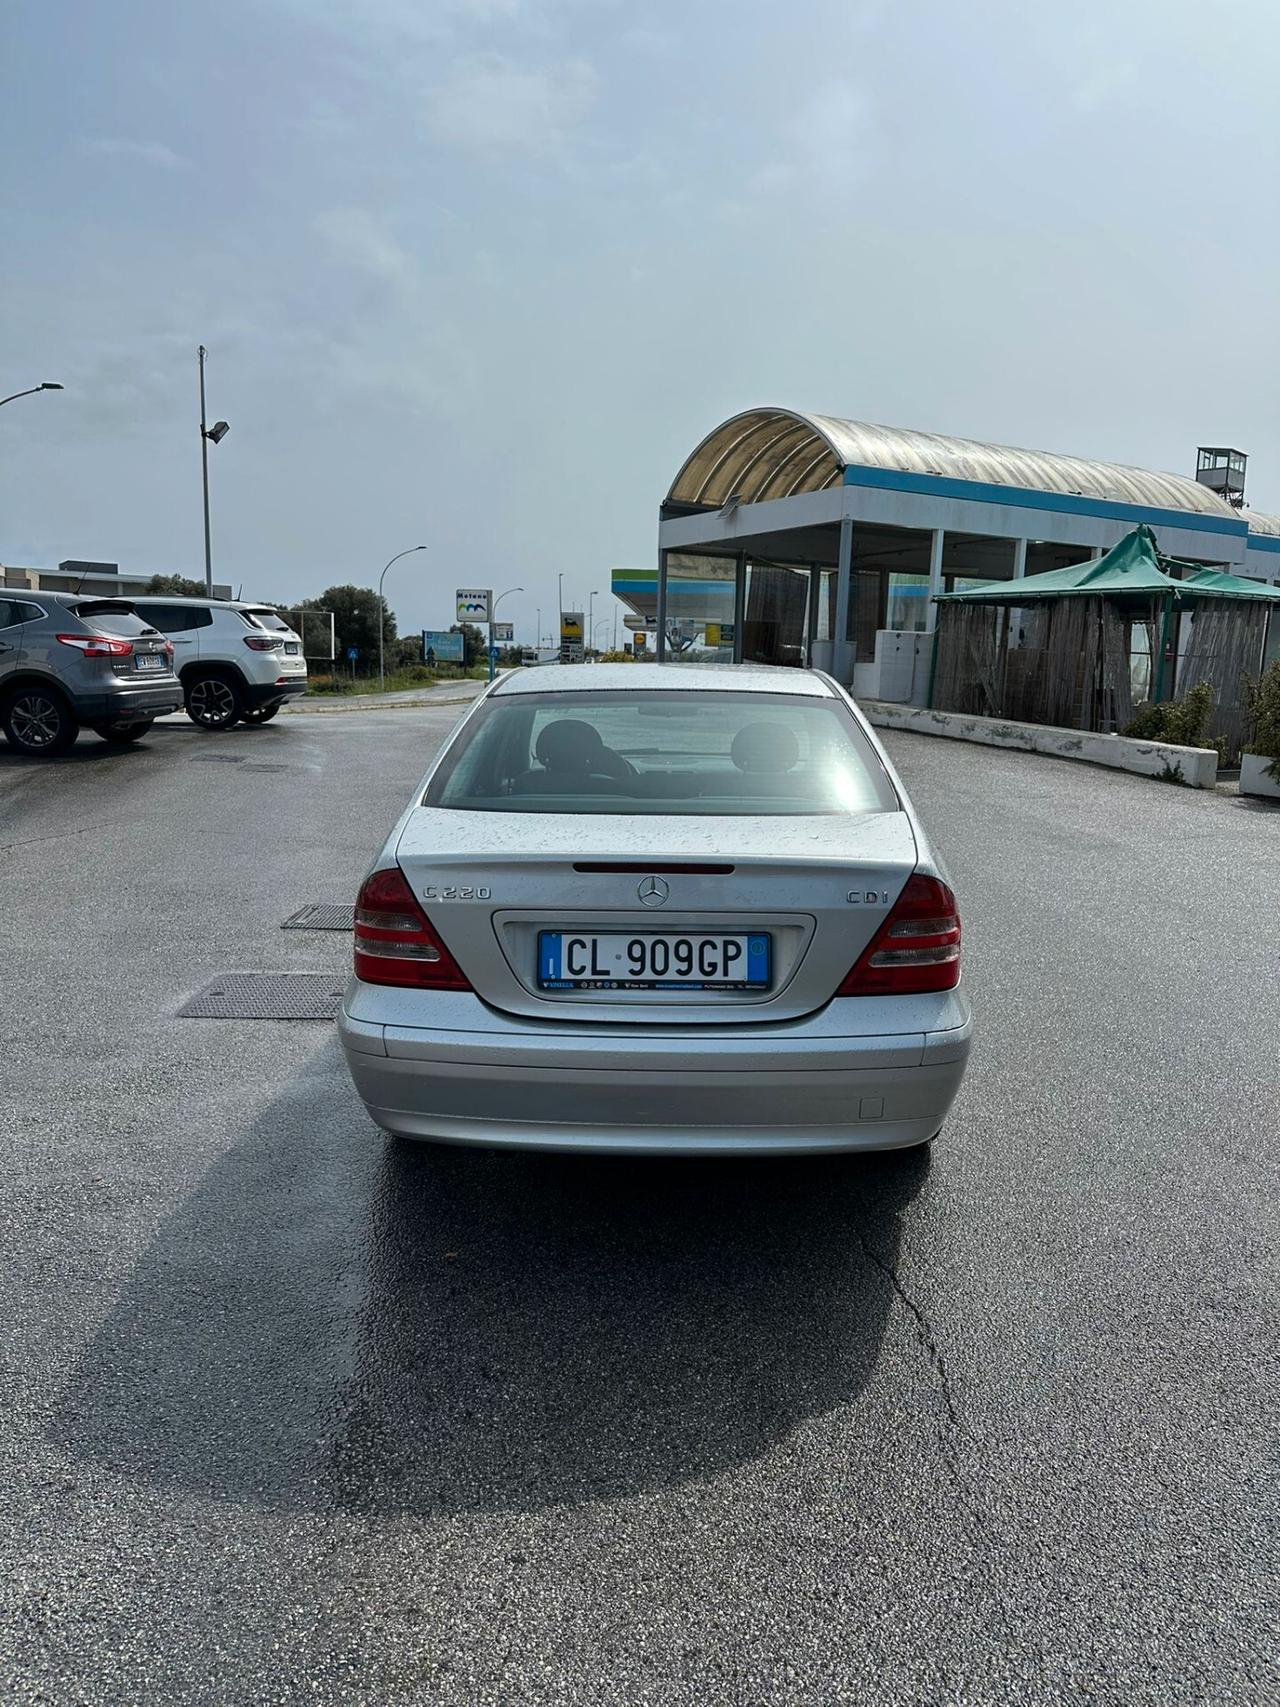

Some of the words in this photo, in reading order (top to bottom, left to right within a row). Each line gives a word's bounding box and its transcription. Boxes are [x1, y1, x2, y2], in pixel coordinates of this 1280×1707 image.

[423, 886, 437, 898] C
[442, 886, 492, 900] 220
[846, 890, 888, 903] CDI
[567, 938, 611, 976] CL
[627, 938, 742, 977] 909GP
